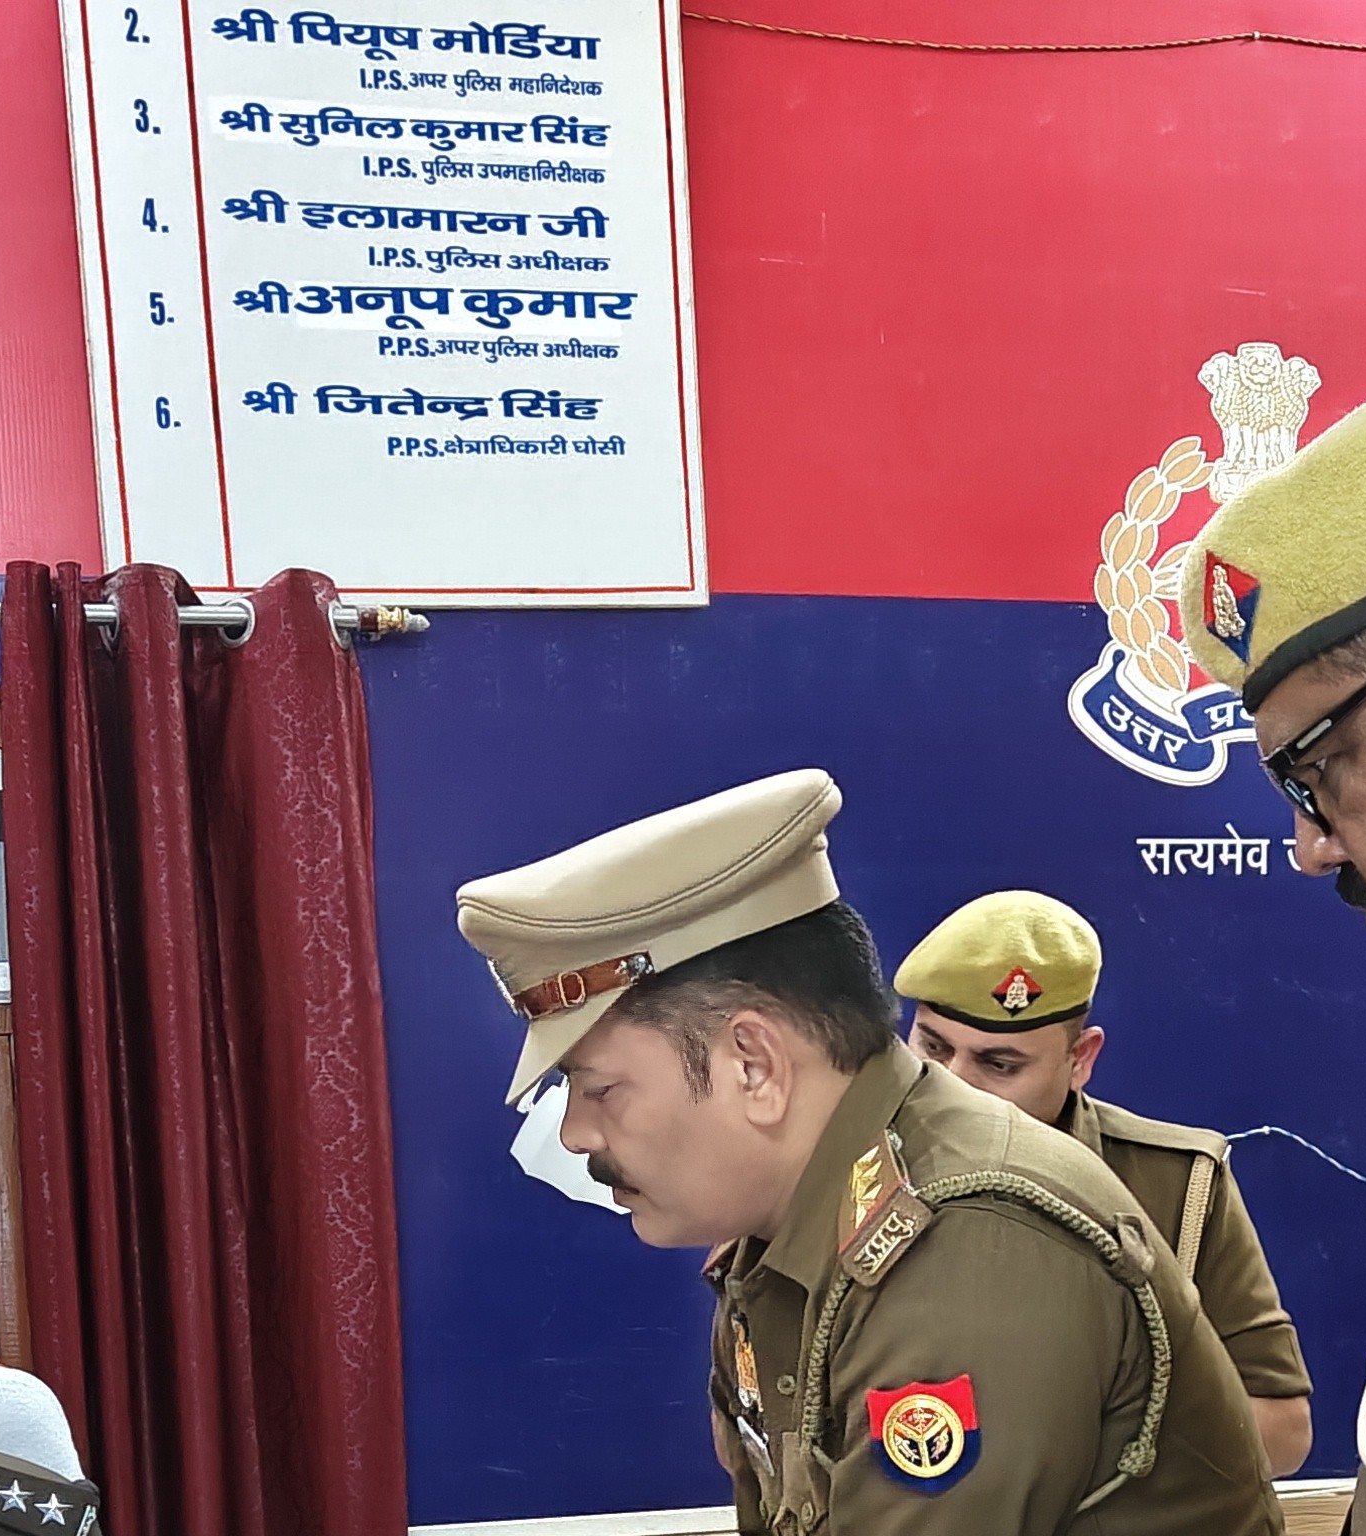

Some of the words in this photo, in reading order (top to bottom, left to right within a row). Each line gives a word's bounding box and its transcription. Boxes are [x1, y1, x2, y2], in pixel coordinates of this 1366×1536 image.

[124, 7, 150, 44] 2.
[211, 8, 280, 43] श्री
[286, 10, 423, 61] पियूष
[430, 21, 601, 60] मोर्डिया
[452, 69, 502, 98] पुलिस
[507, 72, 603, 96] महानिदेशक
[133, 98, 161, 135] 3.
[219, 102, 274, 133] श्री
[278, 106, 407, 147] सुनिल
[409, 118, 528, 152] कुमार
[529, 114, 612, 147] सिंह
[363, 155, 418, 179] I.P.S.
[420, 154, 474, 185] पुलिस
[476, 159, 606, 184] उपमहानिरीक्षक
[142, 197, 170, 234] 4.
[221, 189, 290, 224] श्री
[537, 206, 610, 239] जी
[368, 245, 423, 269] I.P.S.
[424, 245, 502, 274] पुलिस
[506, 249, 611, 272] अधीक्षक
[149, 291, 175, 326] 5.
[232, 280, 293, 314] श्री
[293, 285, 455, 331] अनूप
[460, 288, 639, 330] कुमार
[482, 335, 540, 364] पुलिस
[542, 337, 620, 359] अधीक्षक
[155, 396, 182, 429] 6.
[242, 381, 298, 415] श्री
[312, 384, 494, 421] जितेन्द्र
[498, 388, 603, 421] सिंह
[571, 435, 626, 456] घोसी
[1102, 694, 1188, 764] उत्तर
[1136, 823, 1271, 875] सत्यमेव
